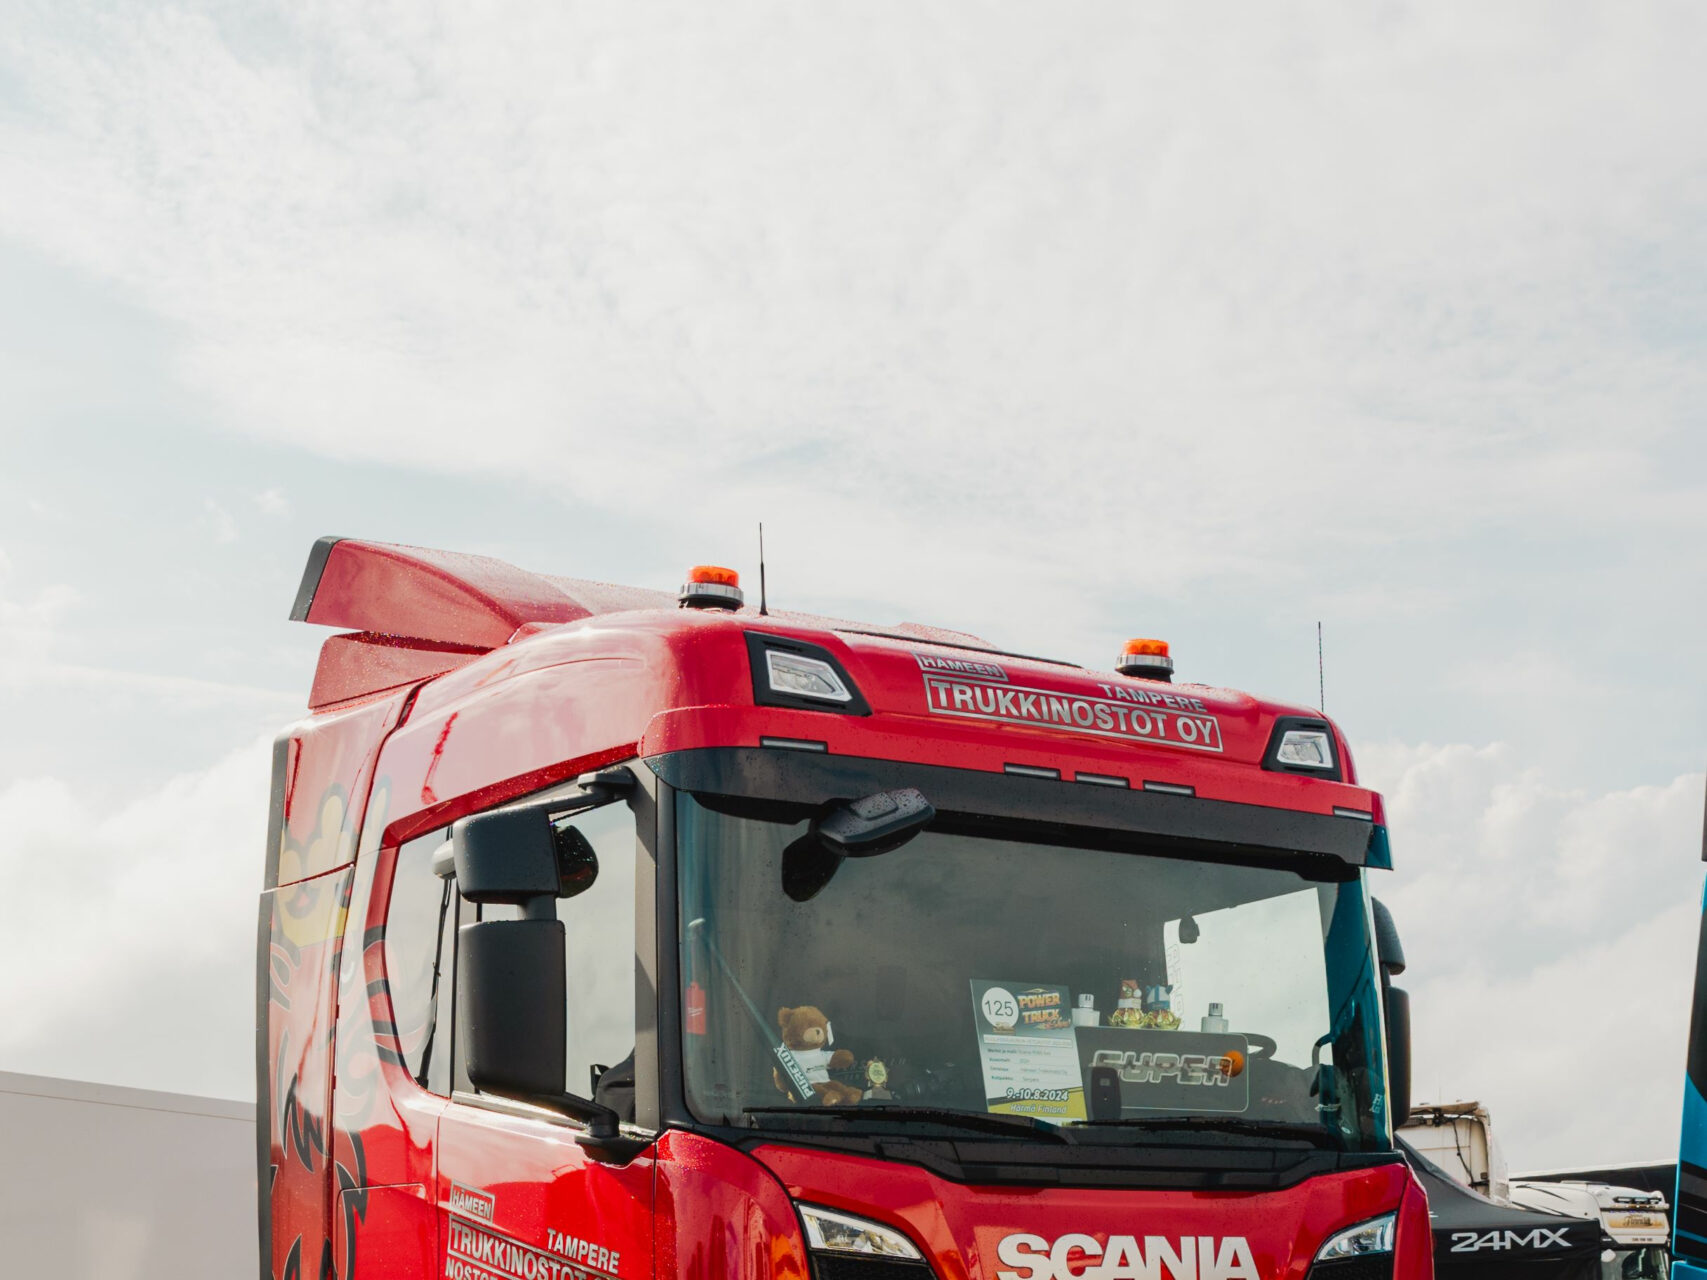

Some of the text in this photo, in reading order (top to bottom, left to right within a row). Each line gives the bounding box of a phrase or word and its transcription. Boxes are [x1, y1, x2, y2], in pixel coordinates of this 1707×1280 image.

[921, 656, 1001, 677] HÄMEEN
[1098, 683, 1208, 712] TAMPERE
[930, 680, 1213, 744] TRUKKINOSTOT OY
[984, 1000, 1014, 1017] 125
[1017, 992, 1061, 1010] POWER
[1022, 1008, 1060, 1024] TRUCK
[774, 1043, 814, 1098] PURELUX
[1090, 1050, 1233, 1087] SUPER
[1006, 1088, 1069, 1101] 9.-10.8.2024
[452, 1189, 492, 1219] HÄMEEN
[547, 1228, 621, 1275] TAMPERE
[1450, 1227, 1572, 1252] 24MX
